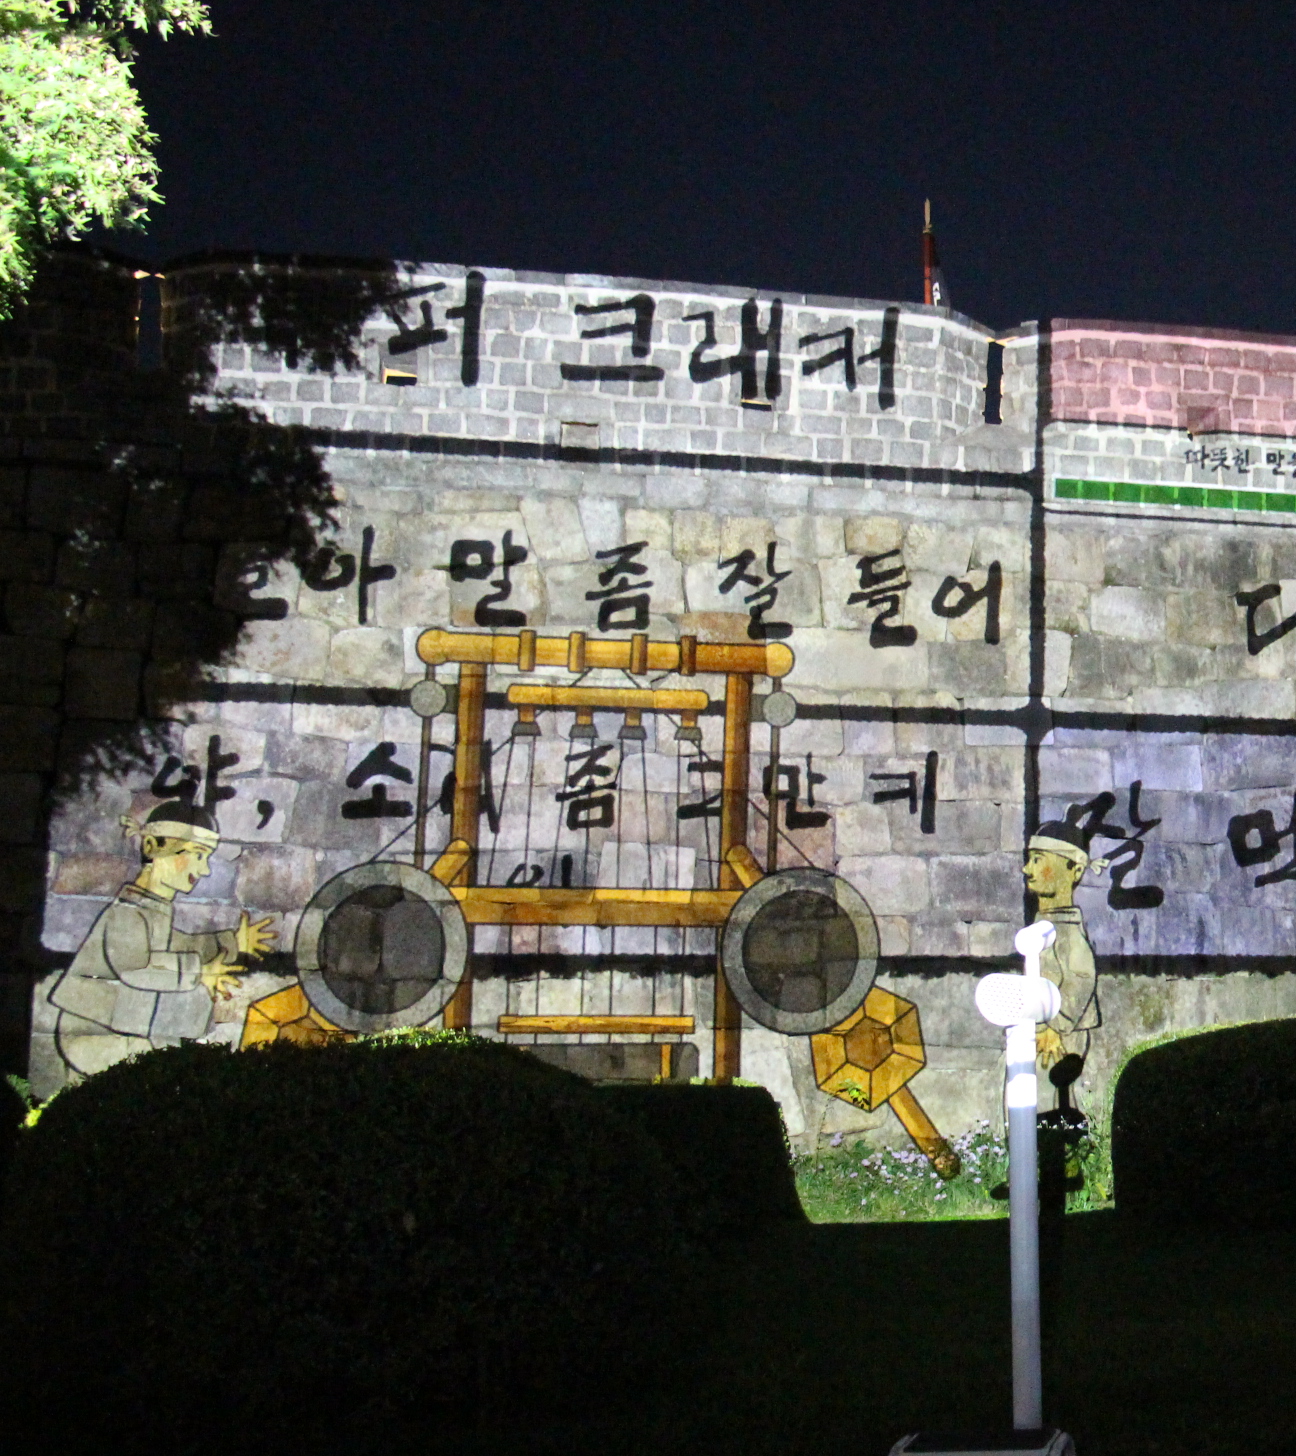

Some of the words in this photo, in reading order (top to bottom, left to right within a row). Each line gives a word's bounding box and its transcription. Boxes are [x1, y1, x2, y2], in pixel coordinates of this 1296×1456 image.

[560, 292, 899, 411] 크래커
[450, 529, 528, 628] 말
[584, 540, 653, 632] 좀
[717, 541, 794, 640] 잘
[846, 548, 1004, 649] 들어
[555, 744, 618, 831] 좀
